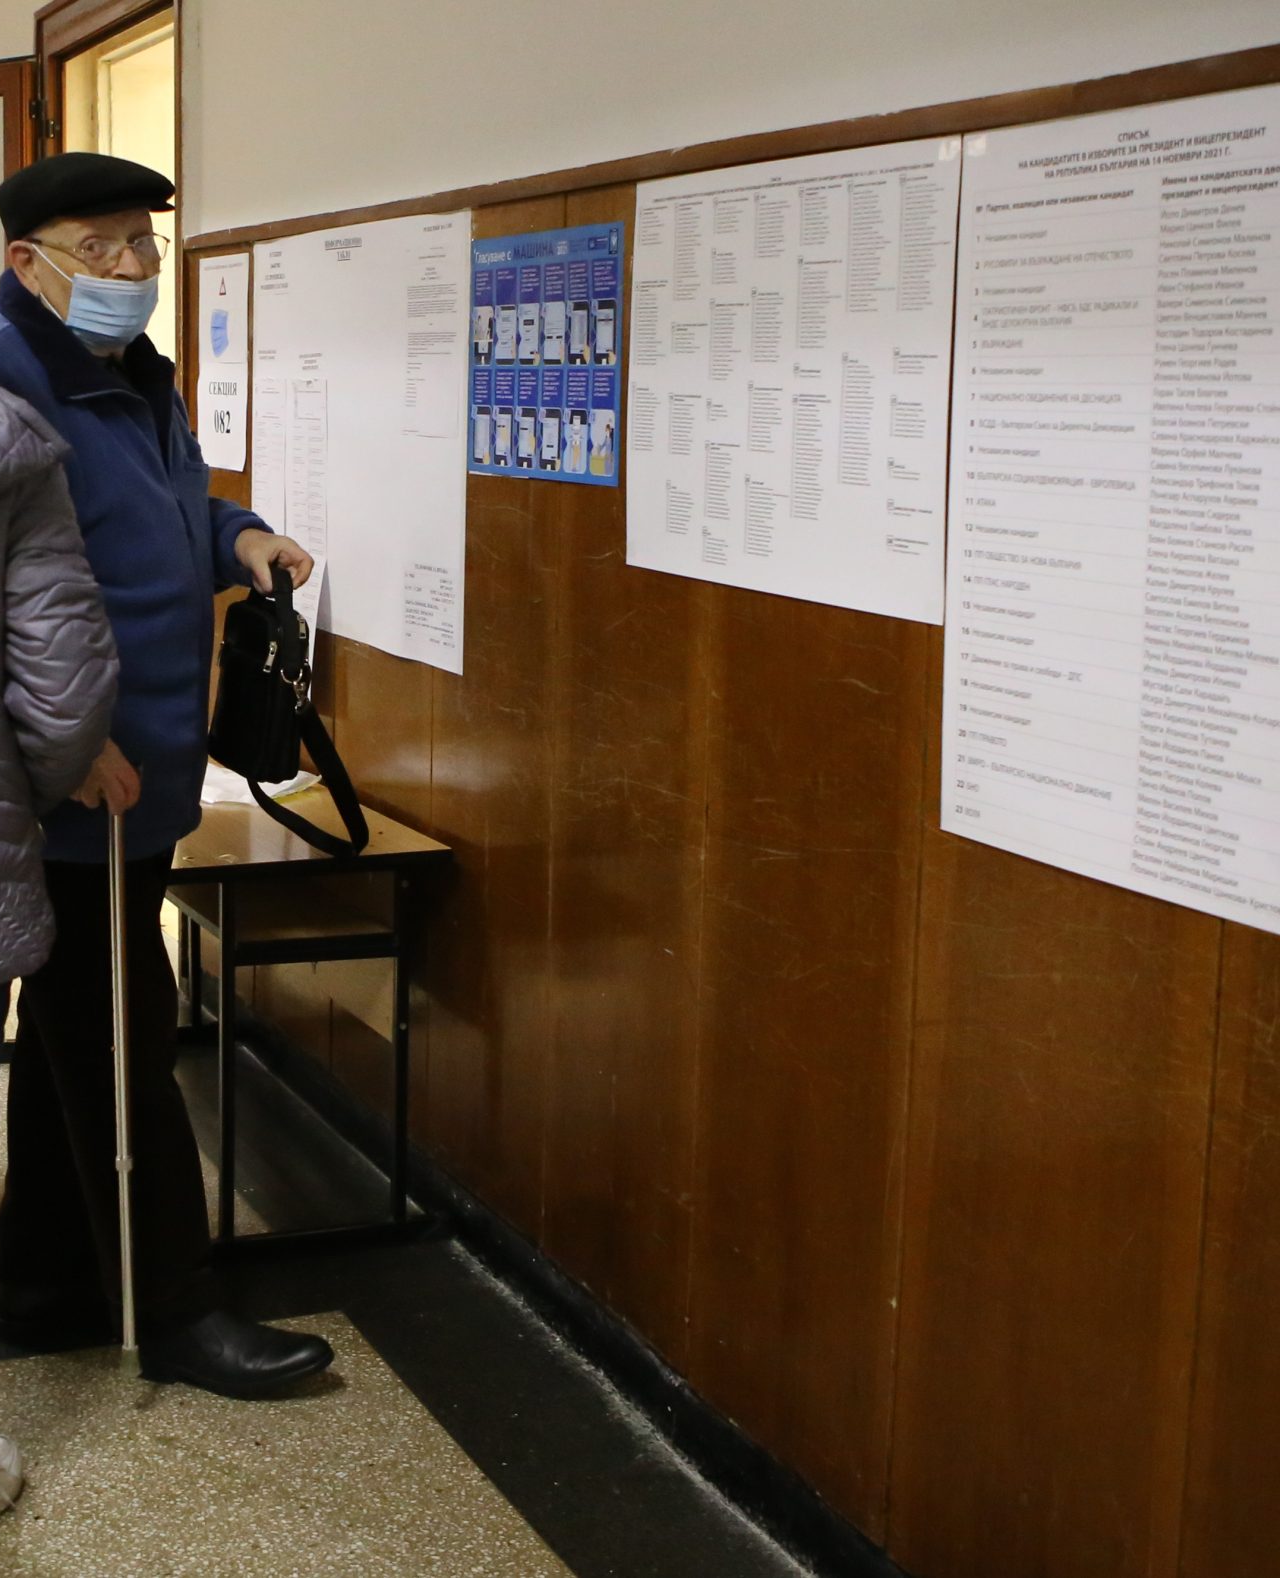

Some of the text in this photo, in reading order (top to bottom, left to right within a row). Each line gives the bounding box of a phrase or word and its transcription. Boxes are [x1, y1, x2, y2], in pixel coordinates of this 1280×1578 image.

[1118, 129, 1150, 142] СПИСЪК
[1018, 160, 1028, 169] НА
[1088, 146, 1126, 160] ИЗБОРИТЕ
[1139, 137, 1184, 153] ПРЕЗИДЕНТ
[1186, 137, 1193, 146] И
[1044, 170, 1054, 178] НА
[1056, 163, 1098, 177] РЕПУБЛИКА
[1099, 158, 1138, 172] БЪЛГАРИЯ
[1139, 157, 1150, 166] НА
[1162, 149, 1202, 163] НОЕМВРИ
[1204, 147, 1222, 159] 2021
[1189, 174, 1199, 182] на
[513, 241, 554, 259] МАШИНА
[209, 381, 237, 396] СЕКЦИЯ
[214, 410, 231, 433] 082
